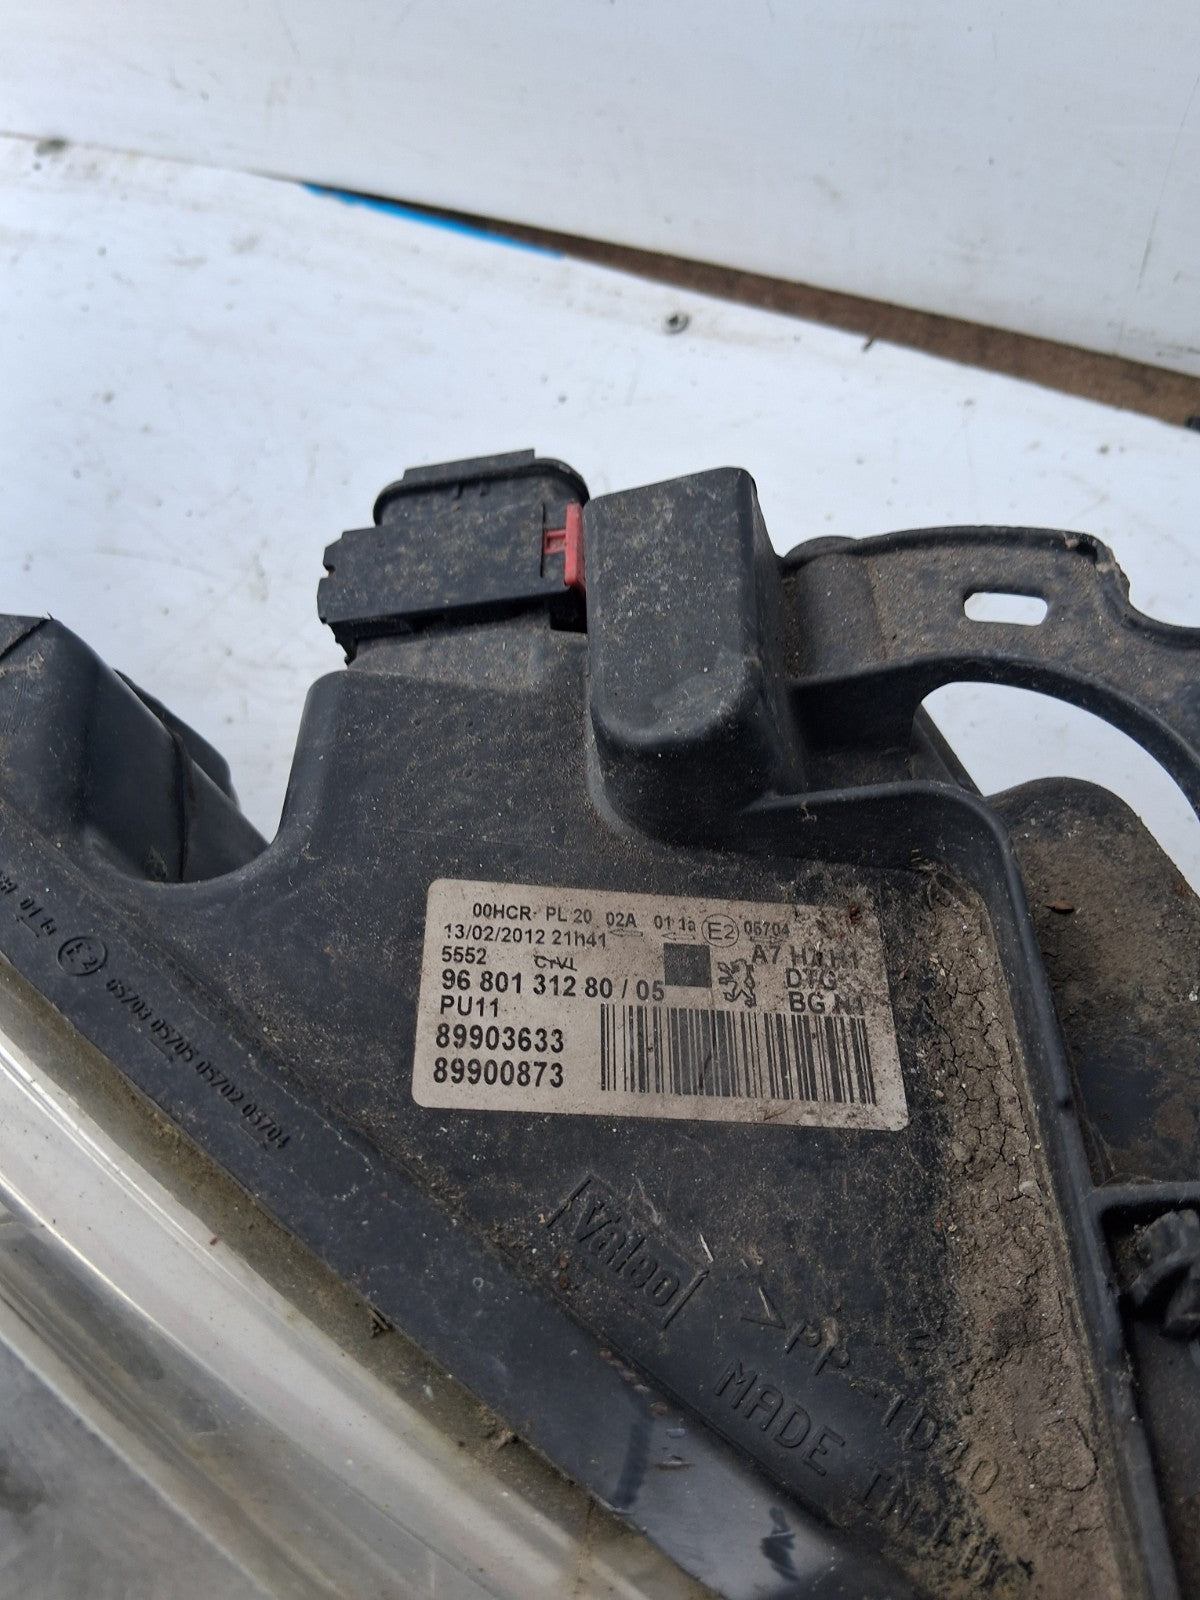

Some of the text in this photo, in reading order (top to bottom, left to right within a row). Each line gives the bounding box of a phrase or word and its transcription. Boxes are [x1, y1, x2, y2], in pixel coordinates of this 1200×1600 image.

[444, 923, 607, 948] 13/02/2012 21h41
[545, 906, 568, 922] PL
[573, 908, 592, 925] 20
[605, 911, 637, 929] 02A
[707, 921, 735, 941] E2
[441, 945, 487, 966] 5552
[442, 969, 471, 990] 96
[479, 971, 522, 994] 801
[533, 974, 577, 997] 312
[584, 977, 613, 999] 80
[636, 980, 664, 1001] 05
[440, 995, 500, 1018] PU11
[435, 1023, 564, 1053] 89903633
[433, 1057, 563, 1088] 89900873
[714, 1360, 846, 1477] MADE
